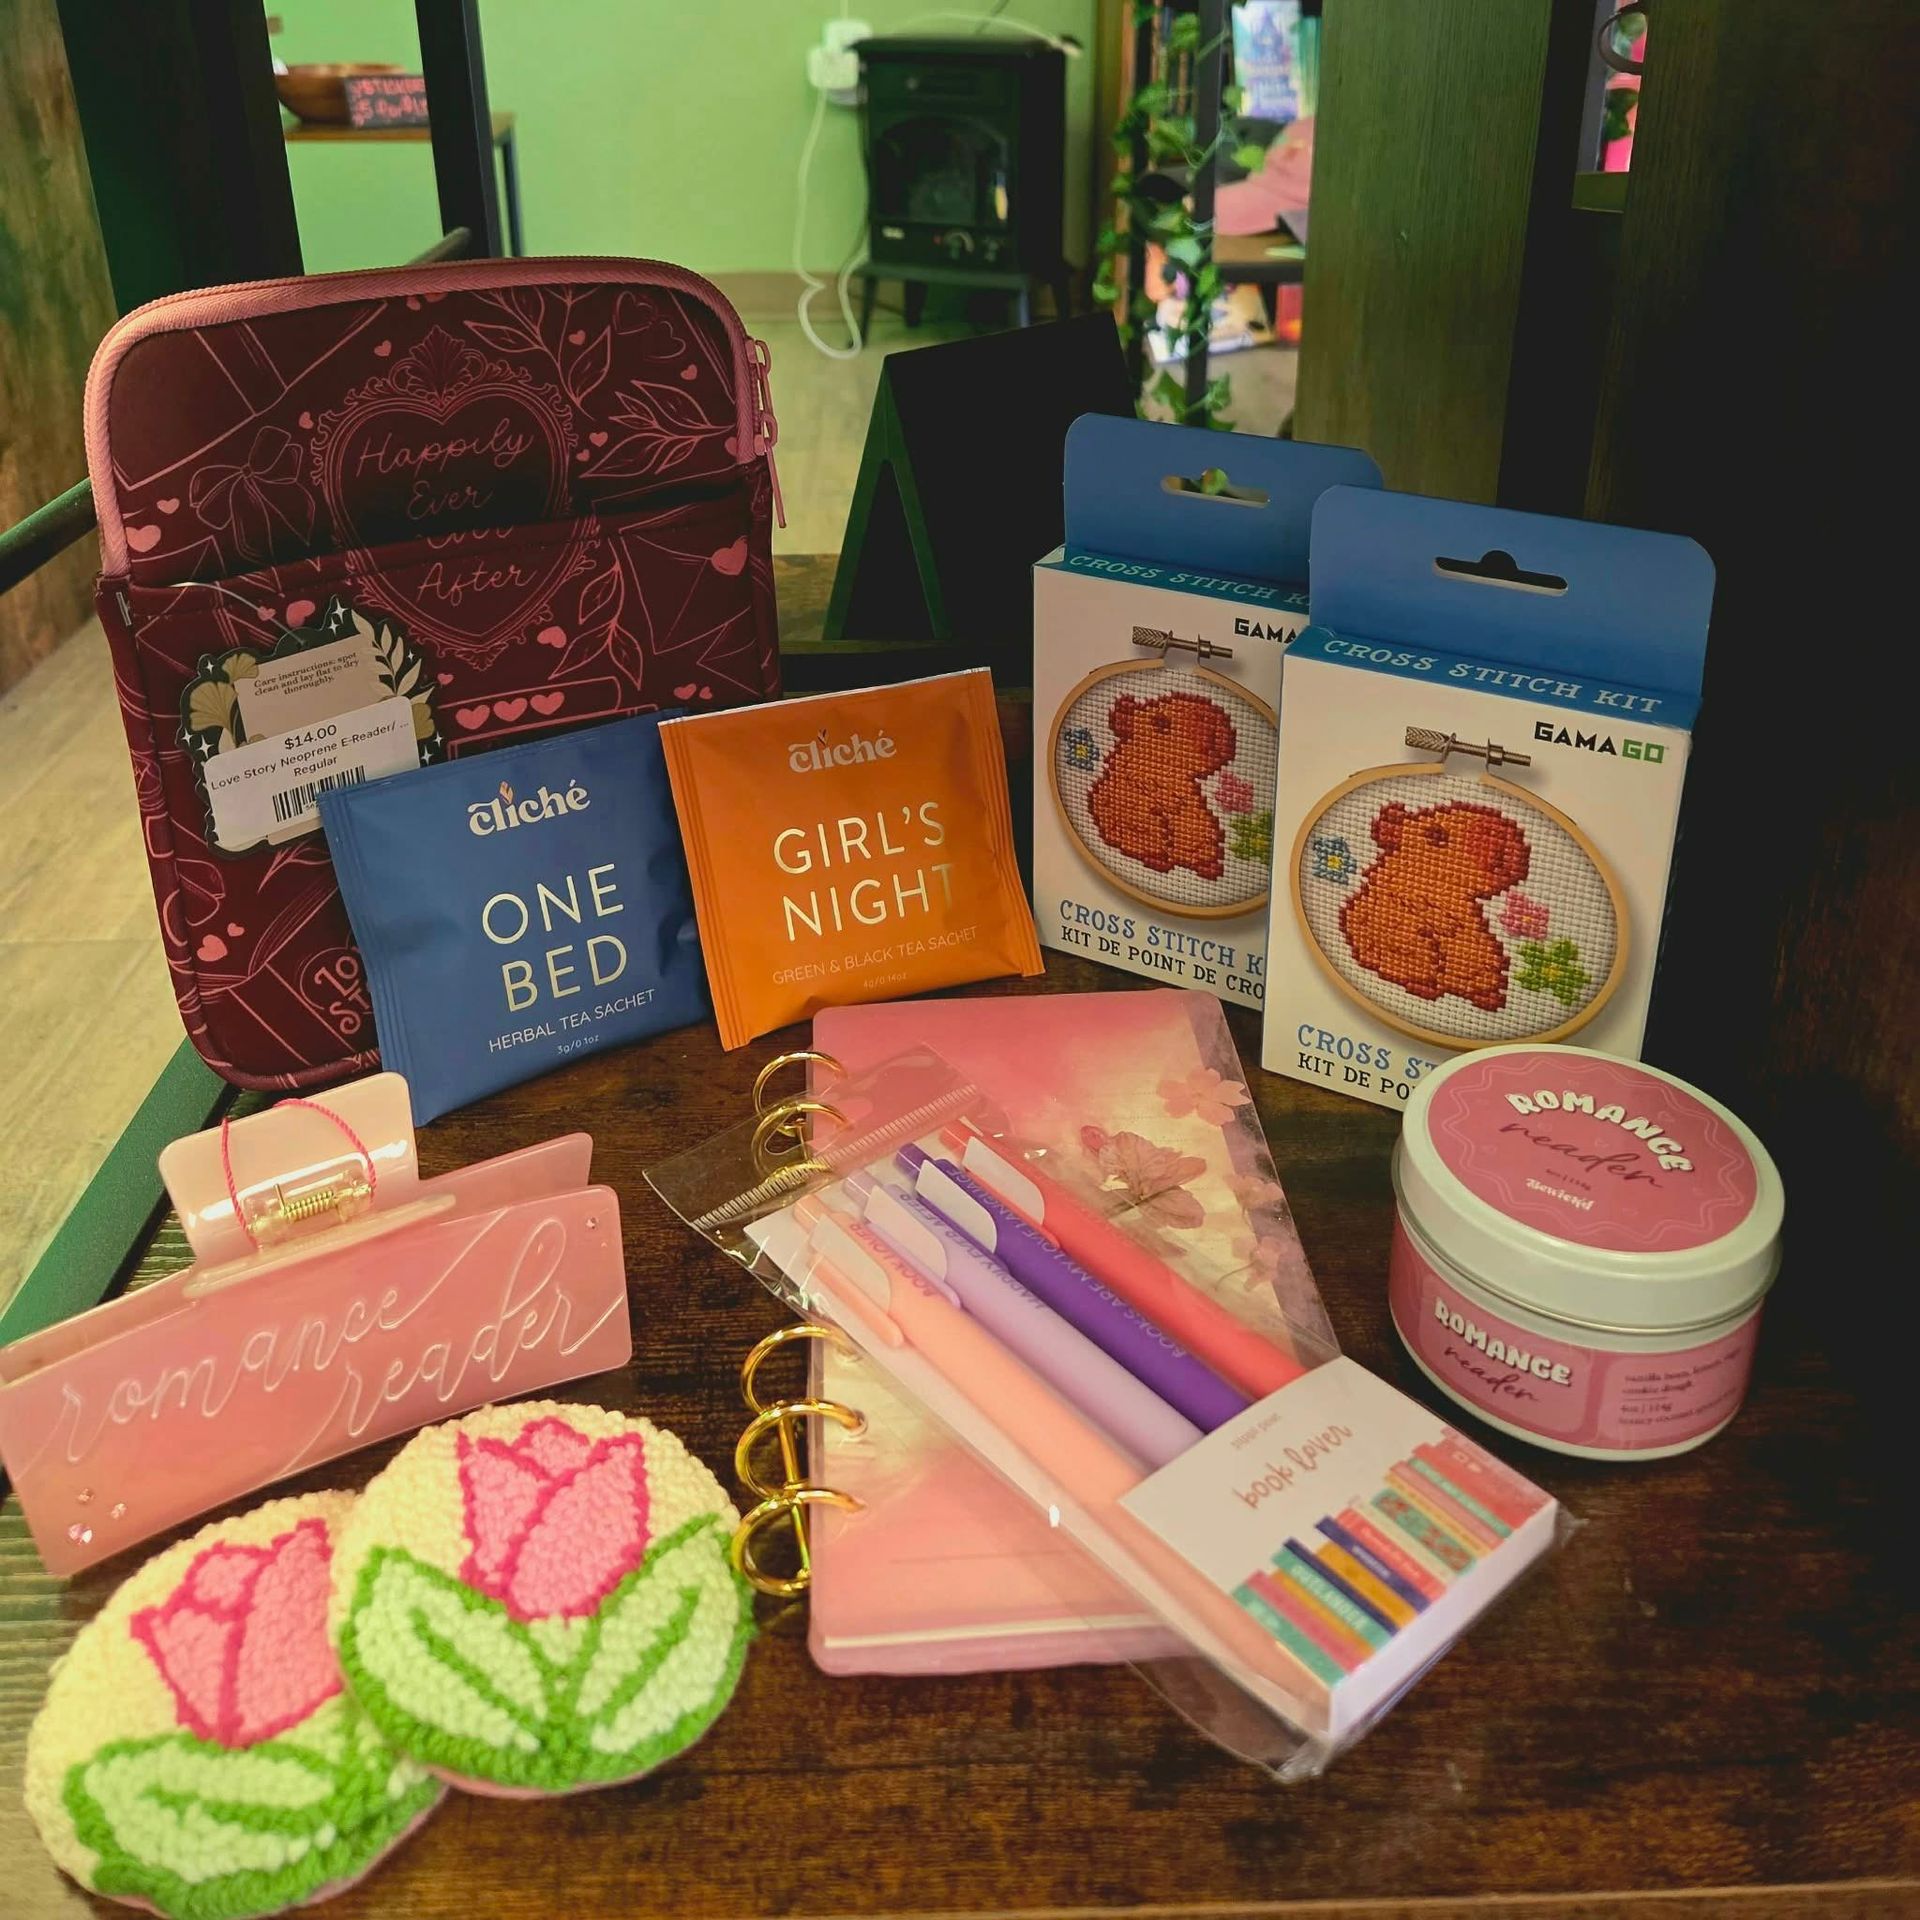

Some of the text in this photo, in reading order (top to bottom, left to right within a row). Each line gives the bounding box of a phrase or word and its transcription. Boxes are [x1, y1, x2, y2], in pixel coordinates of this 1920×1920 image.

[356, 418, 534, 477] Happily
[407, 480, 493, 520] Ever
[416, 561, 537, 607] After
[1069, 555, 1310, 606] CROSS STITCH K
[254, 652, 357, 689] Care instructions: spot
[254, 658, 360, 697] clean and lay flat to dry
[283, 674, 335, 696] thoroughly.
[1324, 640, 1663, 713] CROSS STITCH KIT
[211, 774, 241, 791] Love
[243, 764, 277, 781] Story
[280, 742, 338, 769] Neoprene
[341, 720, 396, 747] E-Reader/
[284, 724, 337, 750] $14.00
[788, 729, 897, 774] cliché
[293, 756, 338, 778] Regular
[467, 778, 591, 837] cliché
[773, 801, 946, 875] GIRL'S
[482, 863, 624, 945] ONE
[782, 863, 954, 942] NIGHT
[772, 926, 977, 985] GREEN & BLACK TEA SACHET
[1059, 899, 1136, 940] CROSS
[1146, 925, 1236, 968] STITCH
[1061, 925, 1091, 948] KIT
[1098, 935, 1121, 957] DE
[1128, 945, 1186, 976] POINT
[1192, 964, 1217, 985] DE
[502, 934, 627, 1013] BED
[488, 988, 656, 1053] HERBAL TEA SACHET
[1297, 1023, 1392, 1071] CROSS
[1297, 1052, 1416, 1100] KIT DE PO
[1497, 1121, 1664, 1189] reader
[1504, 1089, 1696, 1173] ROMANCE
[898, 1190, 947, 1231] AFTER
[846, 1218, 939, 1301] BOOK LOVER
[1059, 1254, 1094, 1285] MY
[1087, 1277, 1127, 1312] ARE
[280, 1218, 625, 1476] reader
[1121, 1304, 1188, 1361] BOOKS
[1434, 1297, 1572, 1386] ROMANCE
[1443, 1345, 1542, 1402] reader
[1232, 1462, 1293, 1509] book
[1283, 1425, 1353, 1471] lover
